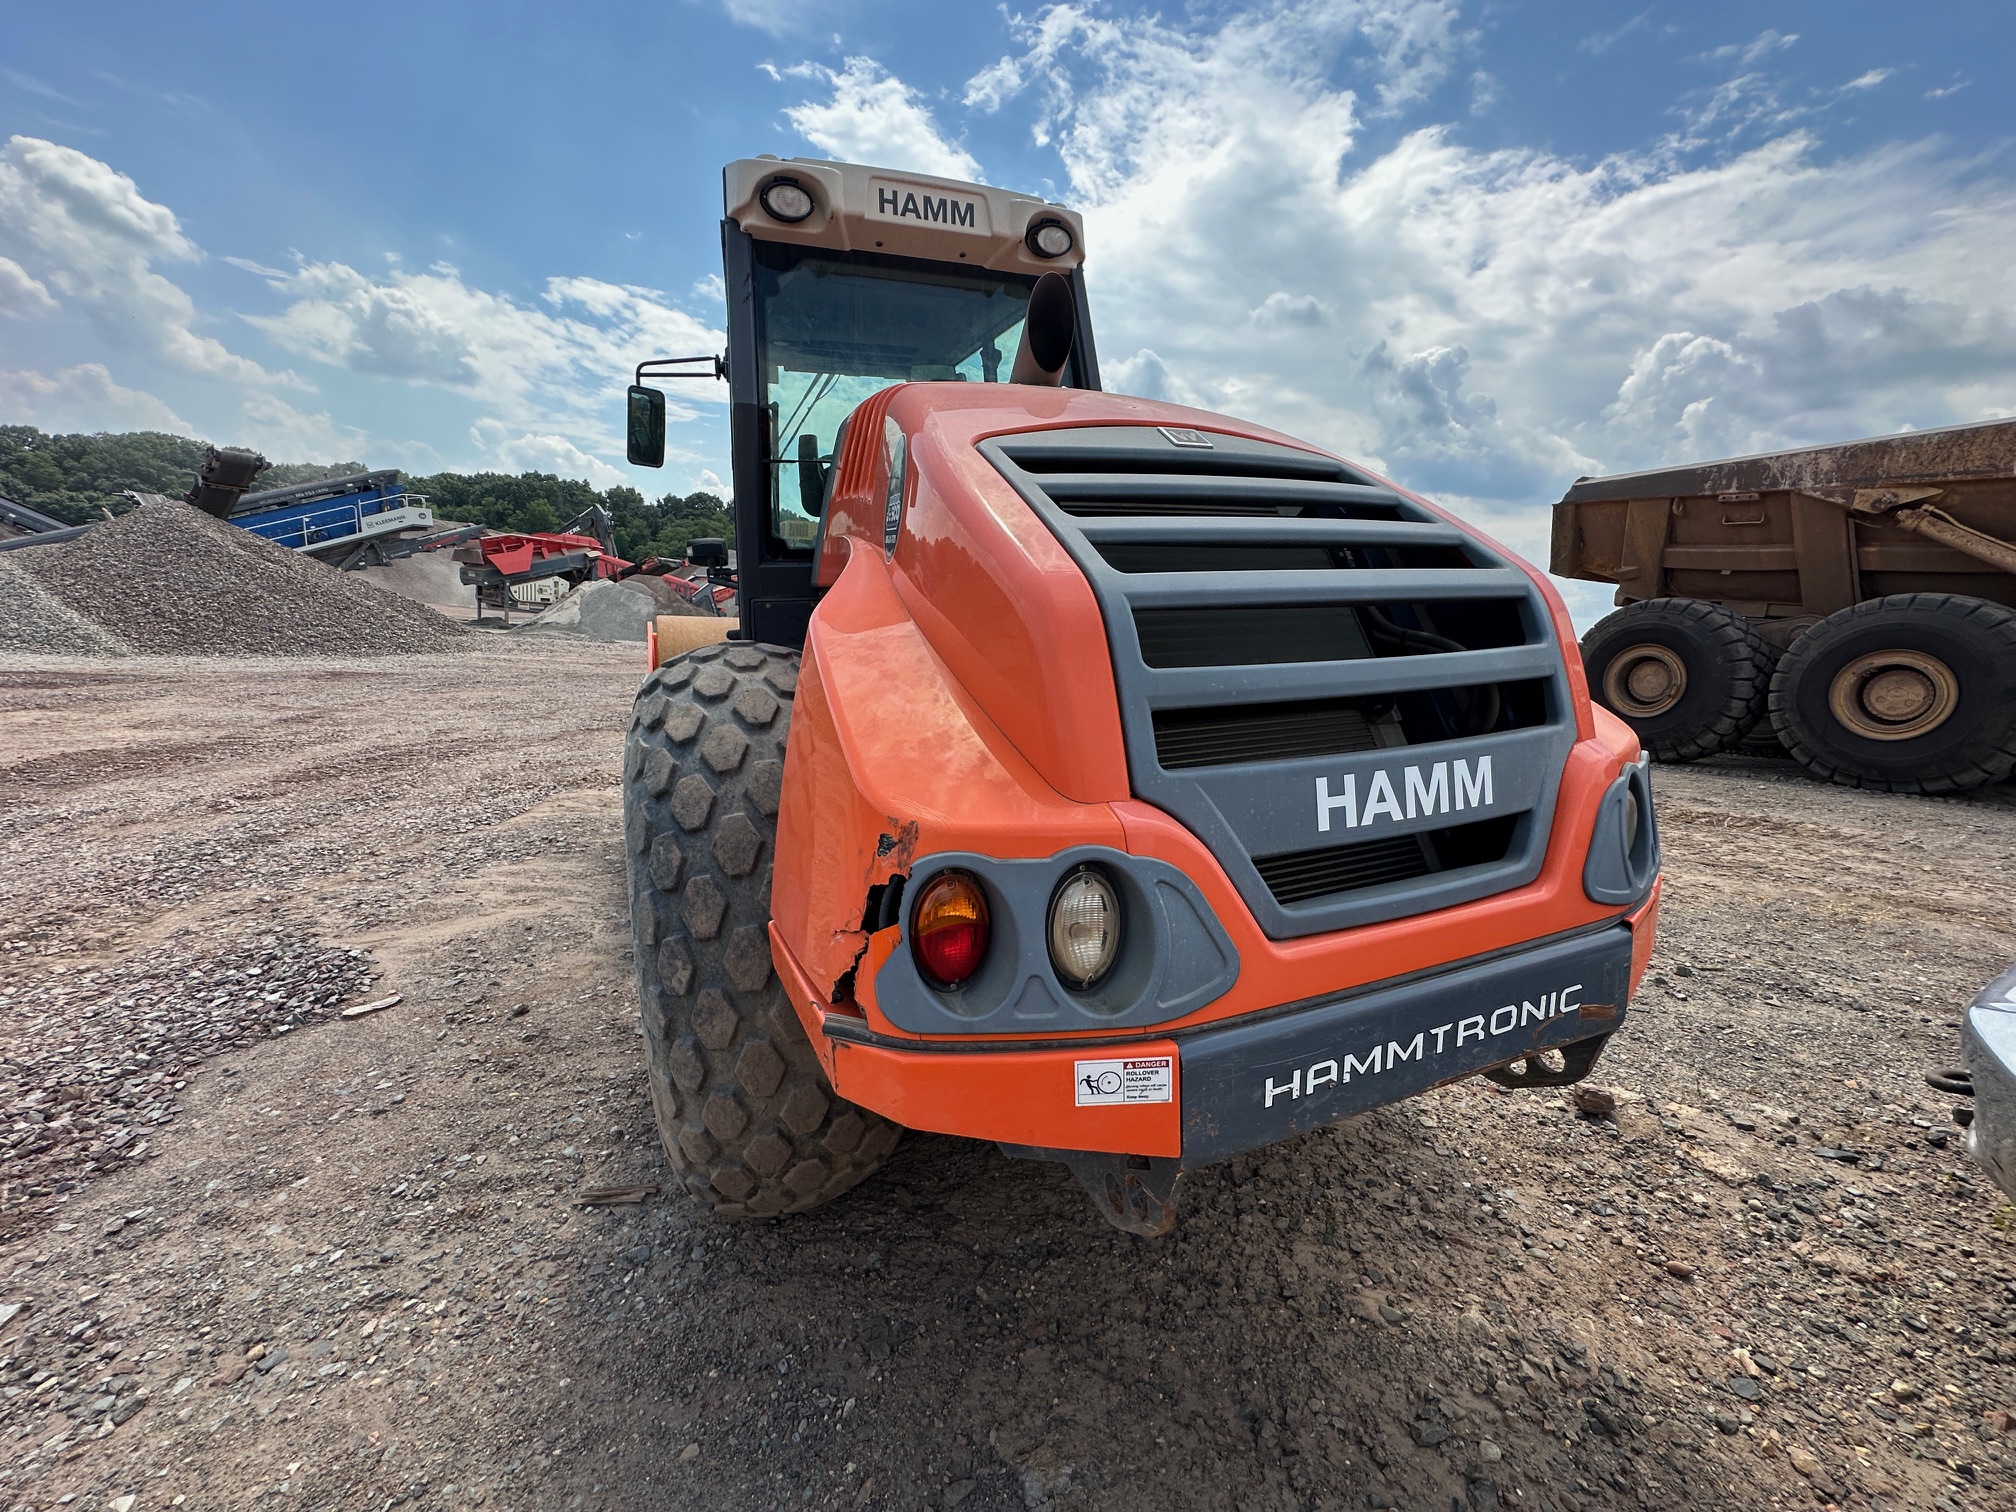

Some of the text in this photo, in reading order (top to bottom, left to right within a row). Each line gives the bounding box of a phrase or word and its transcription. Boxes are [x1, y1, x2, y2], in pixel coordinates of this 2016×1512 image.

[878, 187, 975, 228] HAMM
[375, 515, 406, 526] KLEEMANN
[1315, 755, 1494, 832] HAMM
[1264, 984, 1583, 1108] HAMMTRONIC
